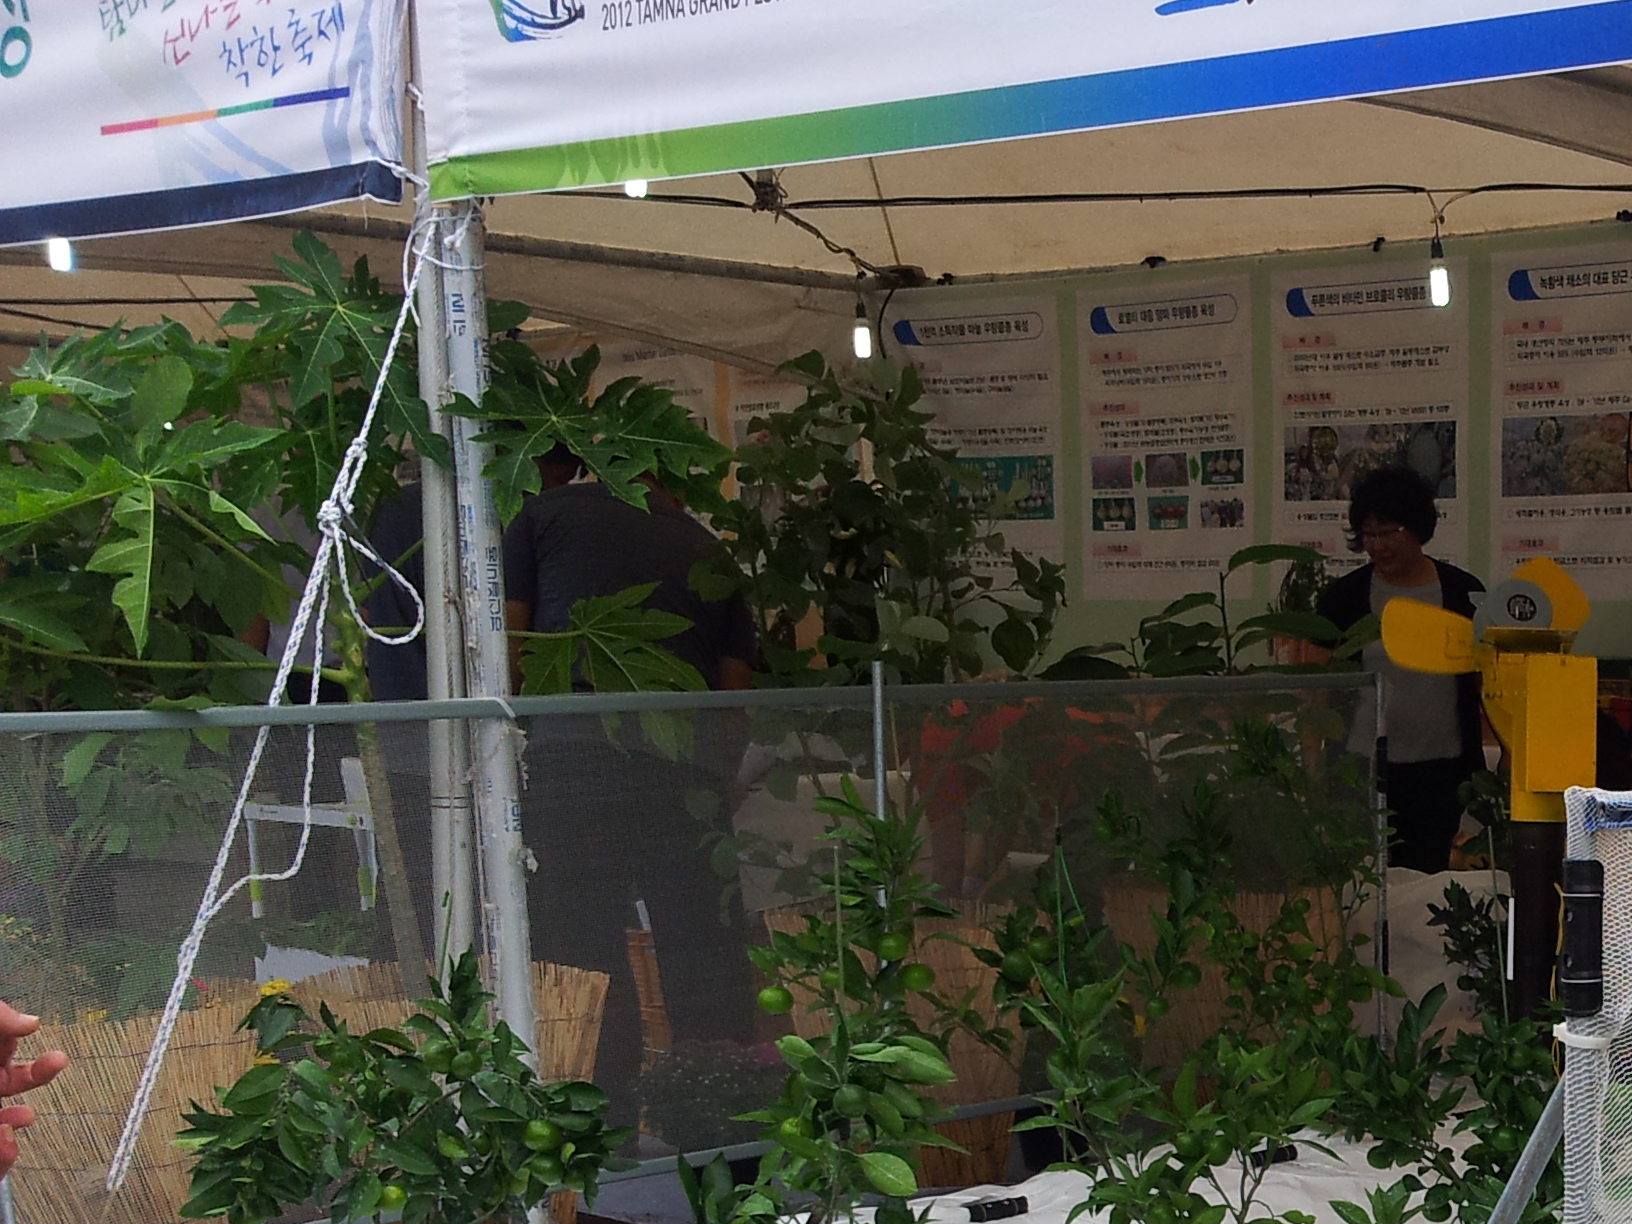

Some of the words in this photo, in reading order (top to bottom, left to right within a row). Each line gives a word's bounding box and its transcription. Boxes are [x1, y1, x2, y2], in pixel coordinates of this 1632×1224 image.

[602, 1, 633, 31] 2012
[637, 0, 686, 24] TAMNA
[219, 26, 284, 88] 착한
[287, 2, 346, 66] 축제
